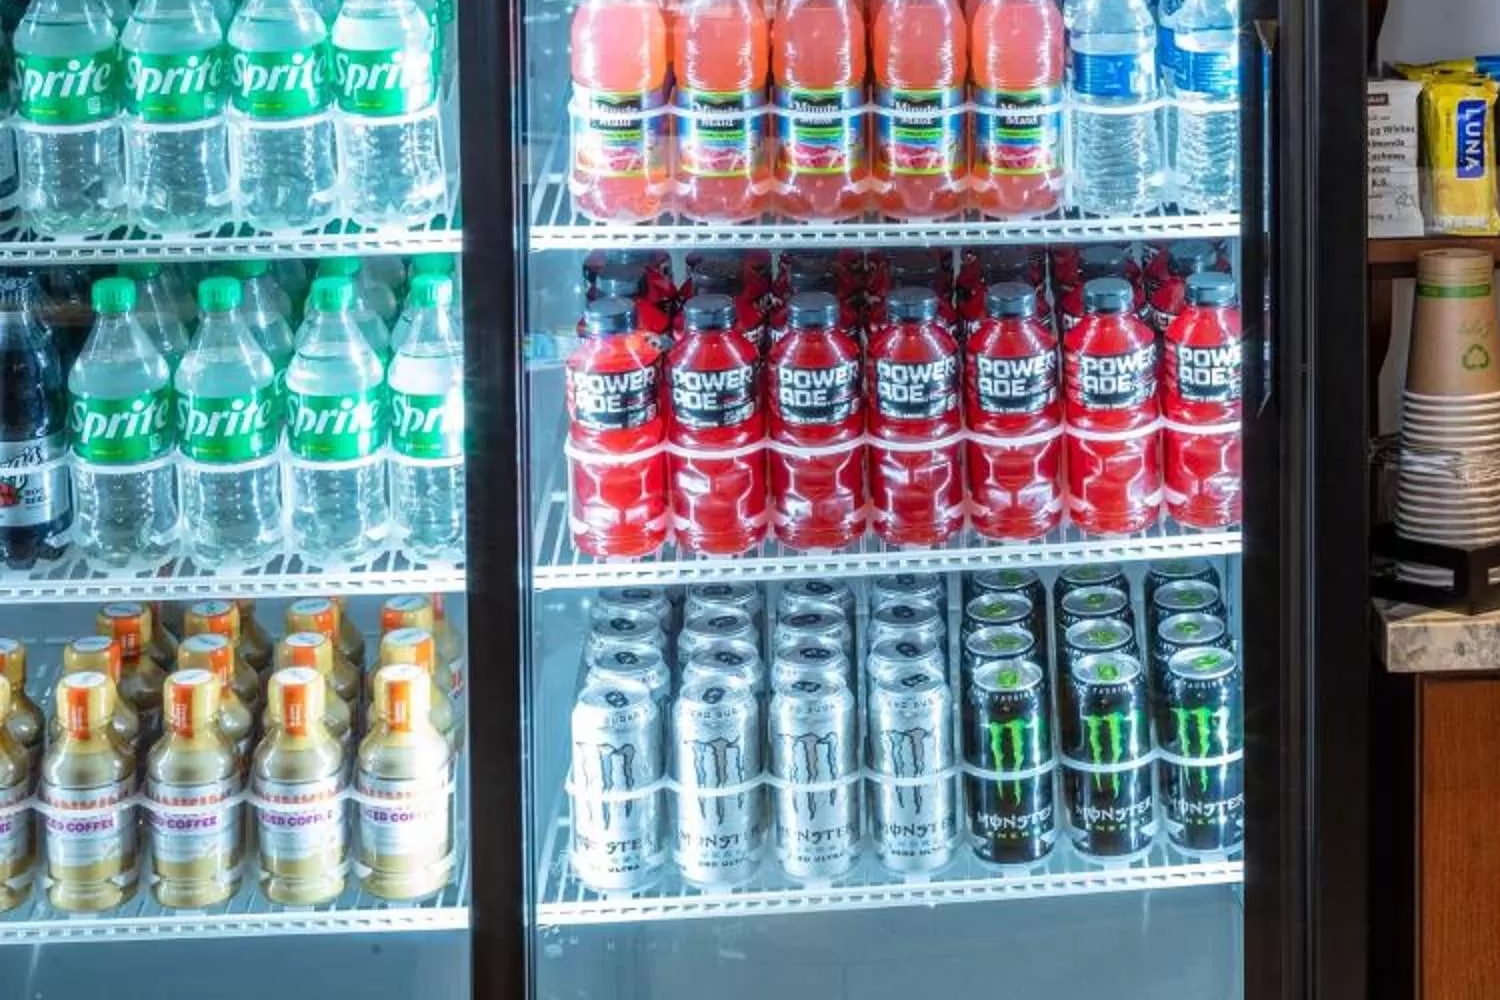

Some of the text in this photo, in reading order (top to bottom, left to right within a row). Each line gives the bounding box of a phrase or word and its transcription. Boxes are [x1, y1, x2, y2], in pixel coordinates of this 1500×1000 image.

[125, 55, 221, 100] Sprite
[335, 54, 412, 99] Spri
[1464, 108, 1481, 172] LUNA
[778, 360, 859, 388] POWER
[876, 357, 955, 384] POWER
[976, 350, 1054, 378] POWER
[1080, 344, 1157, 376] POWER
[574, 367, 656, 395] POWER
[671, 365, 753, 392] POWER
[71, 400, 168, 443] Sprite
[175, 400, 271, 441] Sprite
[66, 818, 114, 834] COFFEE
[167, 815, 218, 830] COFFEE
[287, 809, 334, 827] COFFE
